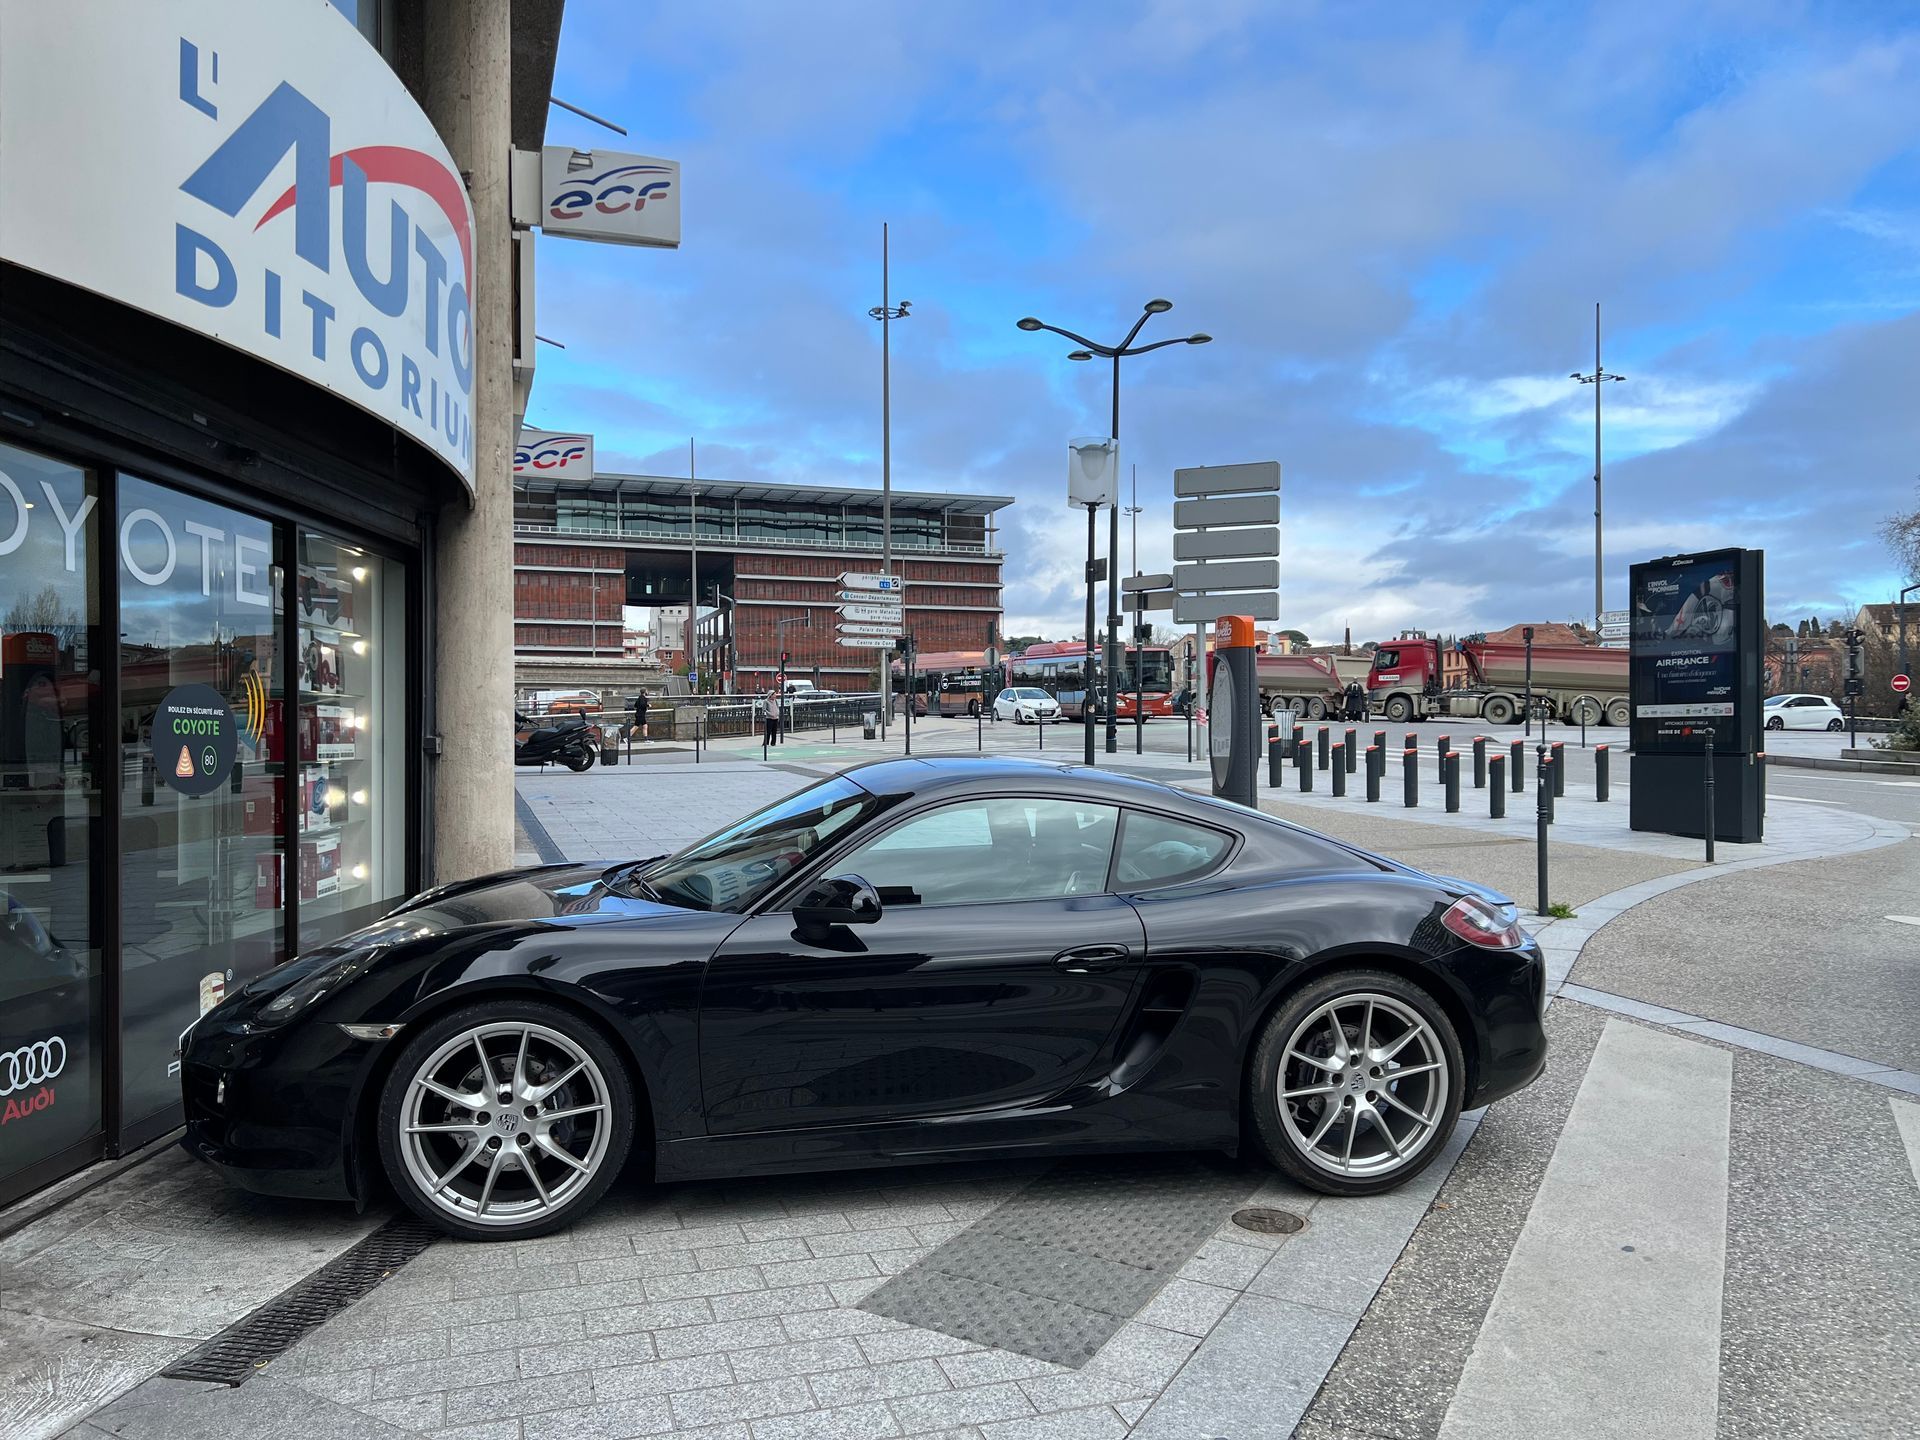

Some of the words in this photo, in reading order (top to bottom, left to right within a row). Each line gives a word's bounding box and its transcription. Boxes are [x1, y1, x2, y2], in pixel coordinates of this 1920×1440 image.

[179, 36, 218, 122] L'
[178, 79, 473, 396] AUTO
[168, 705, 186, 714] ROULEZ
[186, 706, 193, 715] EN
[193, 705, 213, 716] SÉCURITÉ
[213, 708, 224, 717] AVEC
[173, 718, 220, 736] COYOTE
[204, 754, 215, 766] 80
[1, 1086, 56, 1126] Audi
